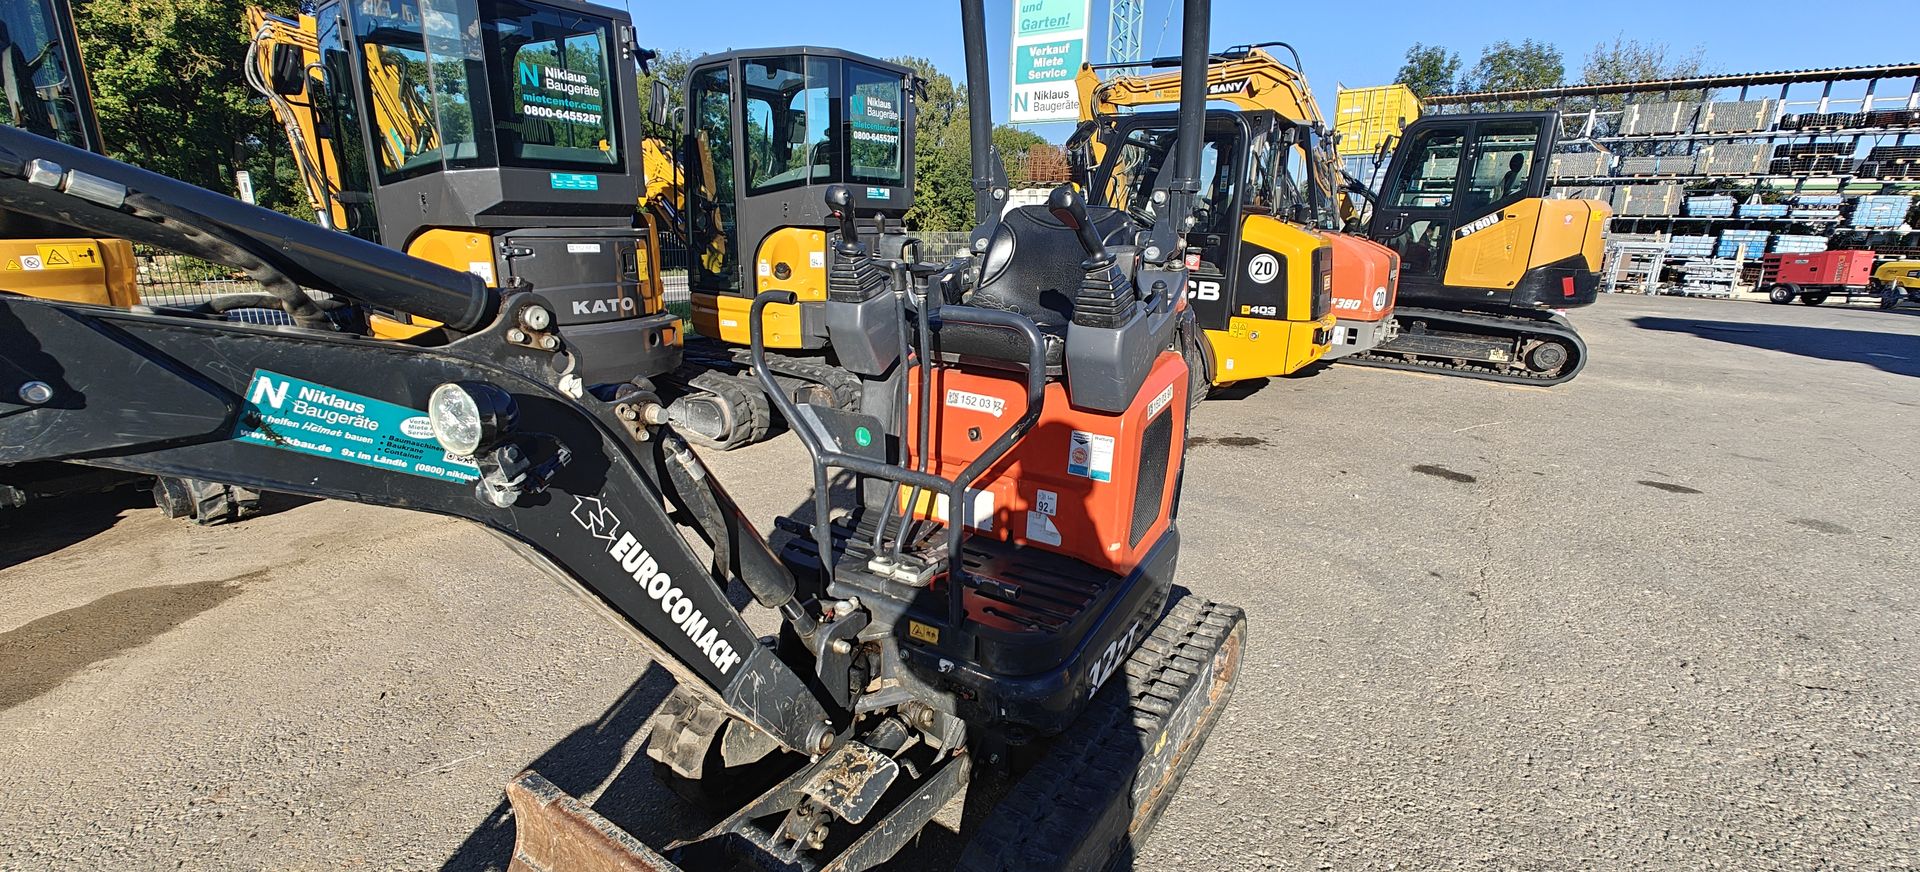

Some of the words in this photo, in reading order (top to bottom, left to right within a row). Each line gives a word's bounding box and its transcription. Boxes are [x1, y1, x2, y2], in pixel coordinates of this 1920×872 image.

[1022, 2, 1043, 13] und
[1021, 13, 1071, 31] Garten!
[1029, 44, 1071, 57] Verkauf
[1033, 57, 1064, 68] Miete
[544, 66, 588, 84] Niklaus
[1028, 69, 1068, 80] Service
[545, 78, 600, 97] Baugeräte
[1209, 82, 1243, 94] SANY
[522, 94, 602, 112] mietcenter.com
[866, 96, 892, 109] Niklaus
[1033, 90, 1070, 101] Niklaus
[867, 107, 898, 120] Baugeräte
[1033, 100, 1080, 113] Baugeräte
[523, 105, 602, 125] 0800-6455287
[1461, 212, 1499, 237] SY80U
[1254, 261, 1273, 276] 20
[1187, 280, 1221, 301] CB
[572, 297, 634, 315] KATO
[1375, 291, 1385, 307] 20
[1250, 305, 1277, 315] 403
[299, 386, 365, 414] Niklaus
[961, 394, 977, 406] 152
[979, 398, 991, 408] 03
[292, 399, 379, 432] Baugeräte
[409, 418, 430, 426] Verka
[266, 415, 300, 428] helfen
[301, 421, 343, 438] Heimat
[344, 432, 374, 445] bauen
[388, 435, 446, 453] Baumaschinen
[383, 448, 423, 461] Container
[341, 448, 355, 459] 9x
[357, 450, 372, 461] im
[415, 463, 445, 477] (0800)
[1038, 501, 1049, 512] 92
